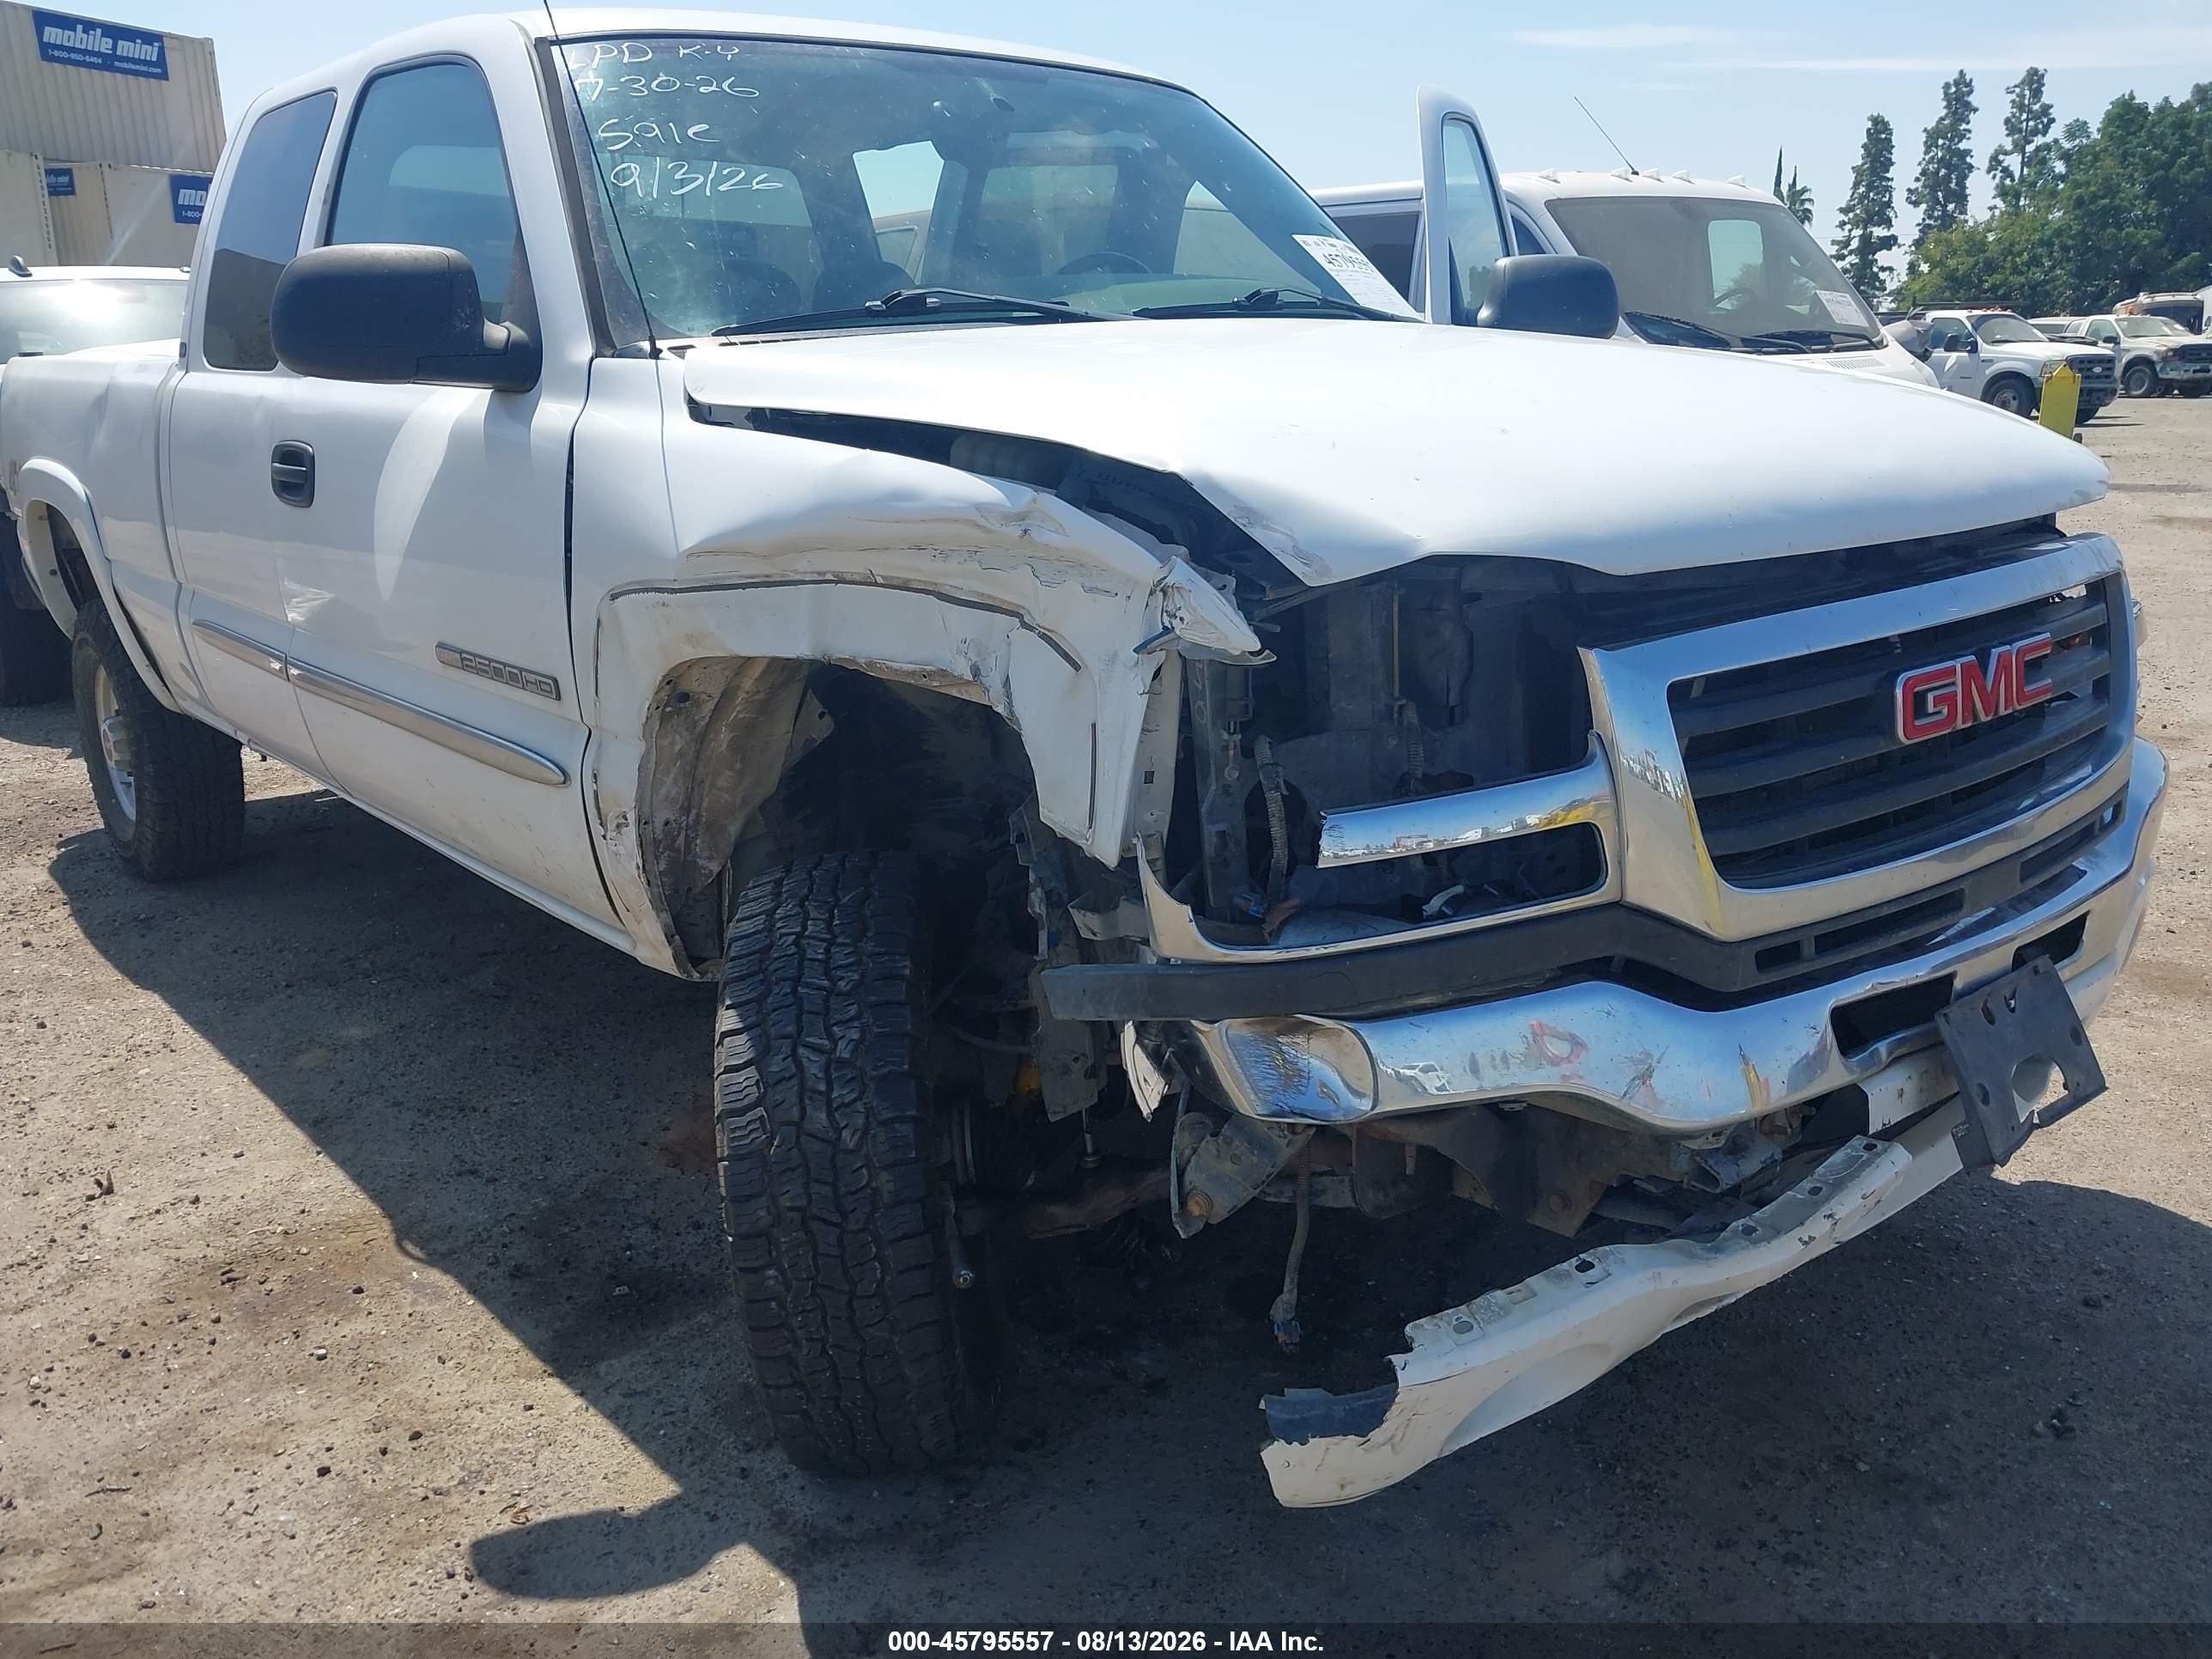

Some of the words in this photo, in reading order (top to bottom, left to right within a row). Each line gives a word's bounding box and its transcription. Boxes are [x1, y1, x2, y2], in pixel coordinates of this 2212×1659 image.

[42, 24, 113, 54] mobile
[116, 40, 160, 62] mini
[574, 74, 760, 102] 7-30-26
[599, 118, 720, 150] Sale
[611, 155, 784, 198] 9/3/26
[1896, 632, 2053, 744] GMC
